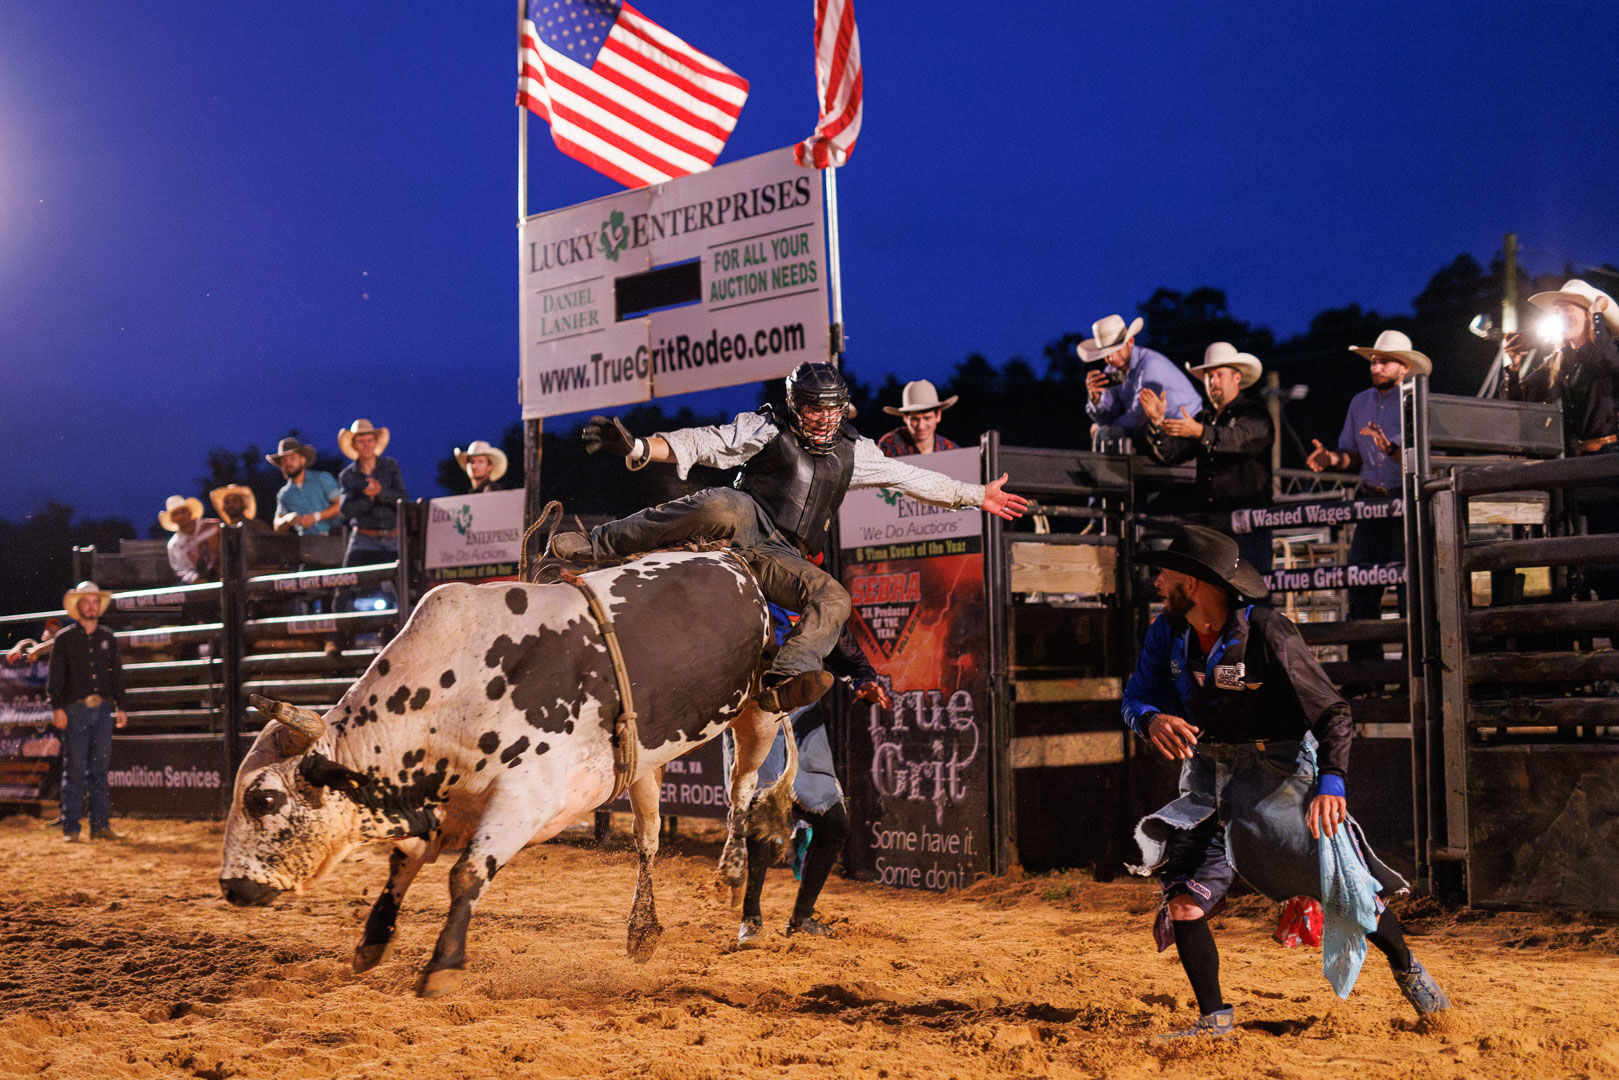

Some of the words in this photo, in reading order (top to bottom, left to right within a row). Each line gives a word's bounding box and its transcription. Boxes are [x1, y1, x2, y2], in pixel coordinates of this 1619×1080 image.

[530, 231, 598, 273] LUCKY
[631, 176, 811, 249] ENTERPRISES
[714, 248, 739, 273] FOR
[744, 242, 767, 267] ALL
[771, 233, 809, 260] YOUR
[710, 270, 767, 302] AUCTION
[771, 260, 817, 289] NEEDS
[543, 287, 595, 314] DANIEL
[541, 309, 599, 336] LANIER
[540, 322, 805, 395] www.TrueGritRodeo.com
[1252, 506, 1302, 527] Wasted
[1305, 504, 1351, 524] Wages
[1354, 501, 1389, 519] Tour
[886, 524, 904, 539] Do
[851, 571, 921, 605] SEBRA
[1313, 567, 1344, 588] Grit
[107, 765, 162, 787] emolition
[165, 765, 221, 788] Services
[871, 739, 970, 825] Grit
[870, 821, 917, 851] Some
[921, 825, 960, 854] have
[964, 827, 978, 856] it.
[874, 857, 921, 887] Some
